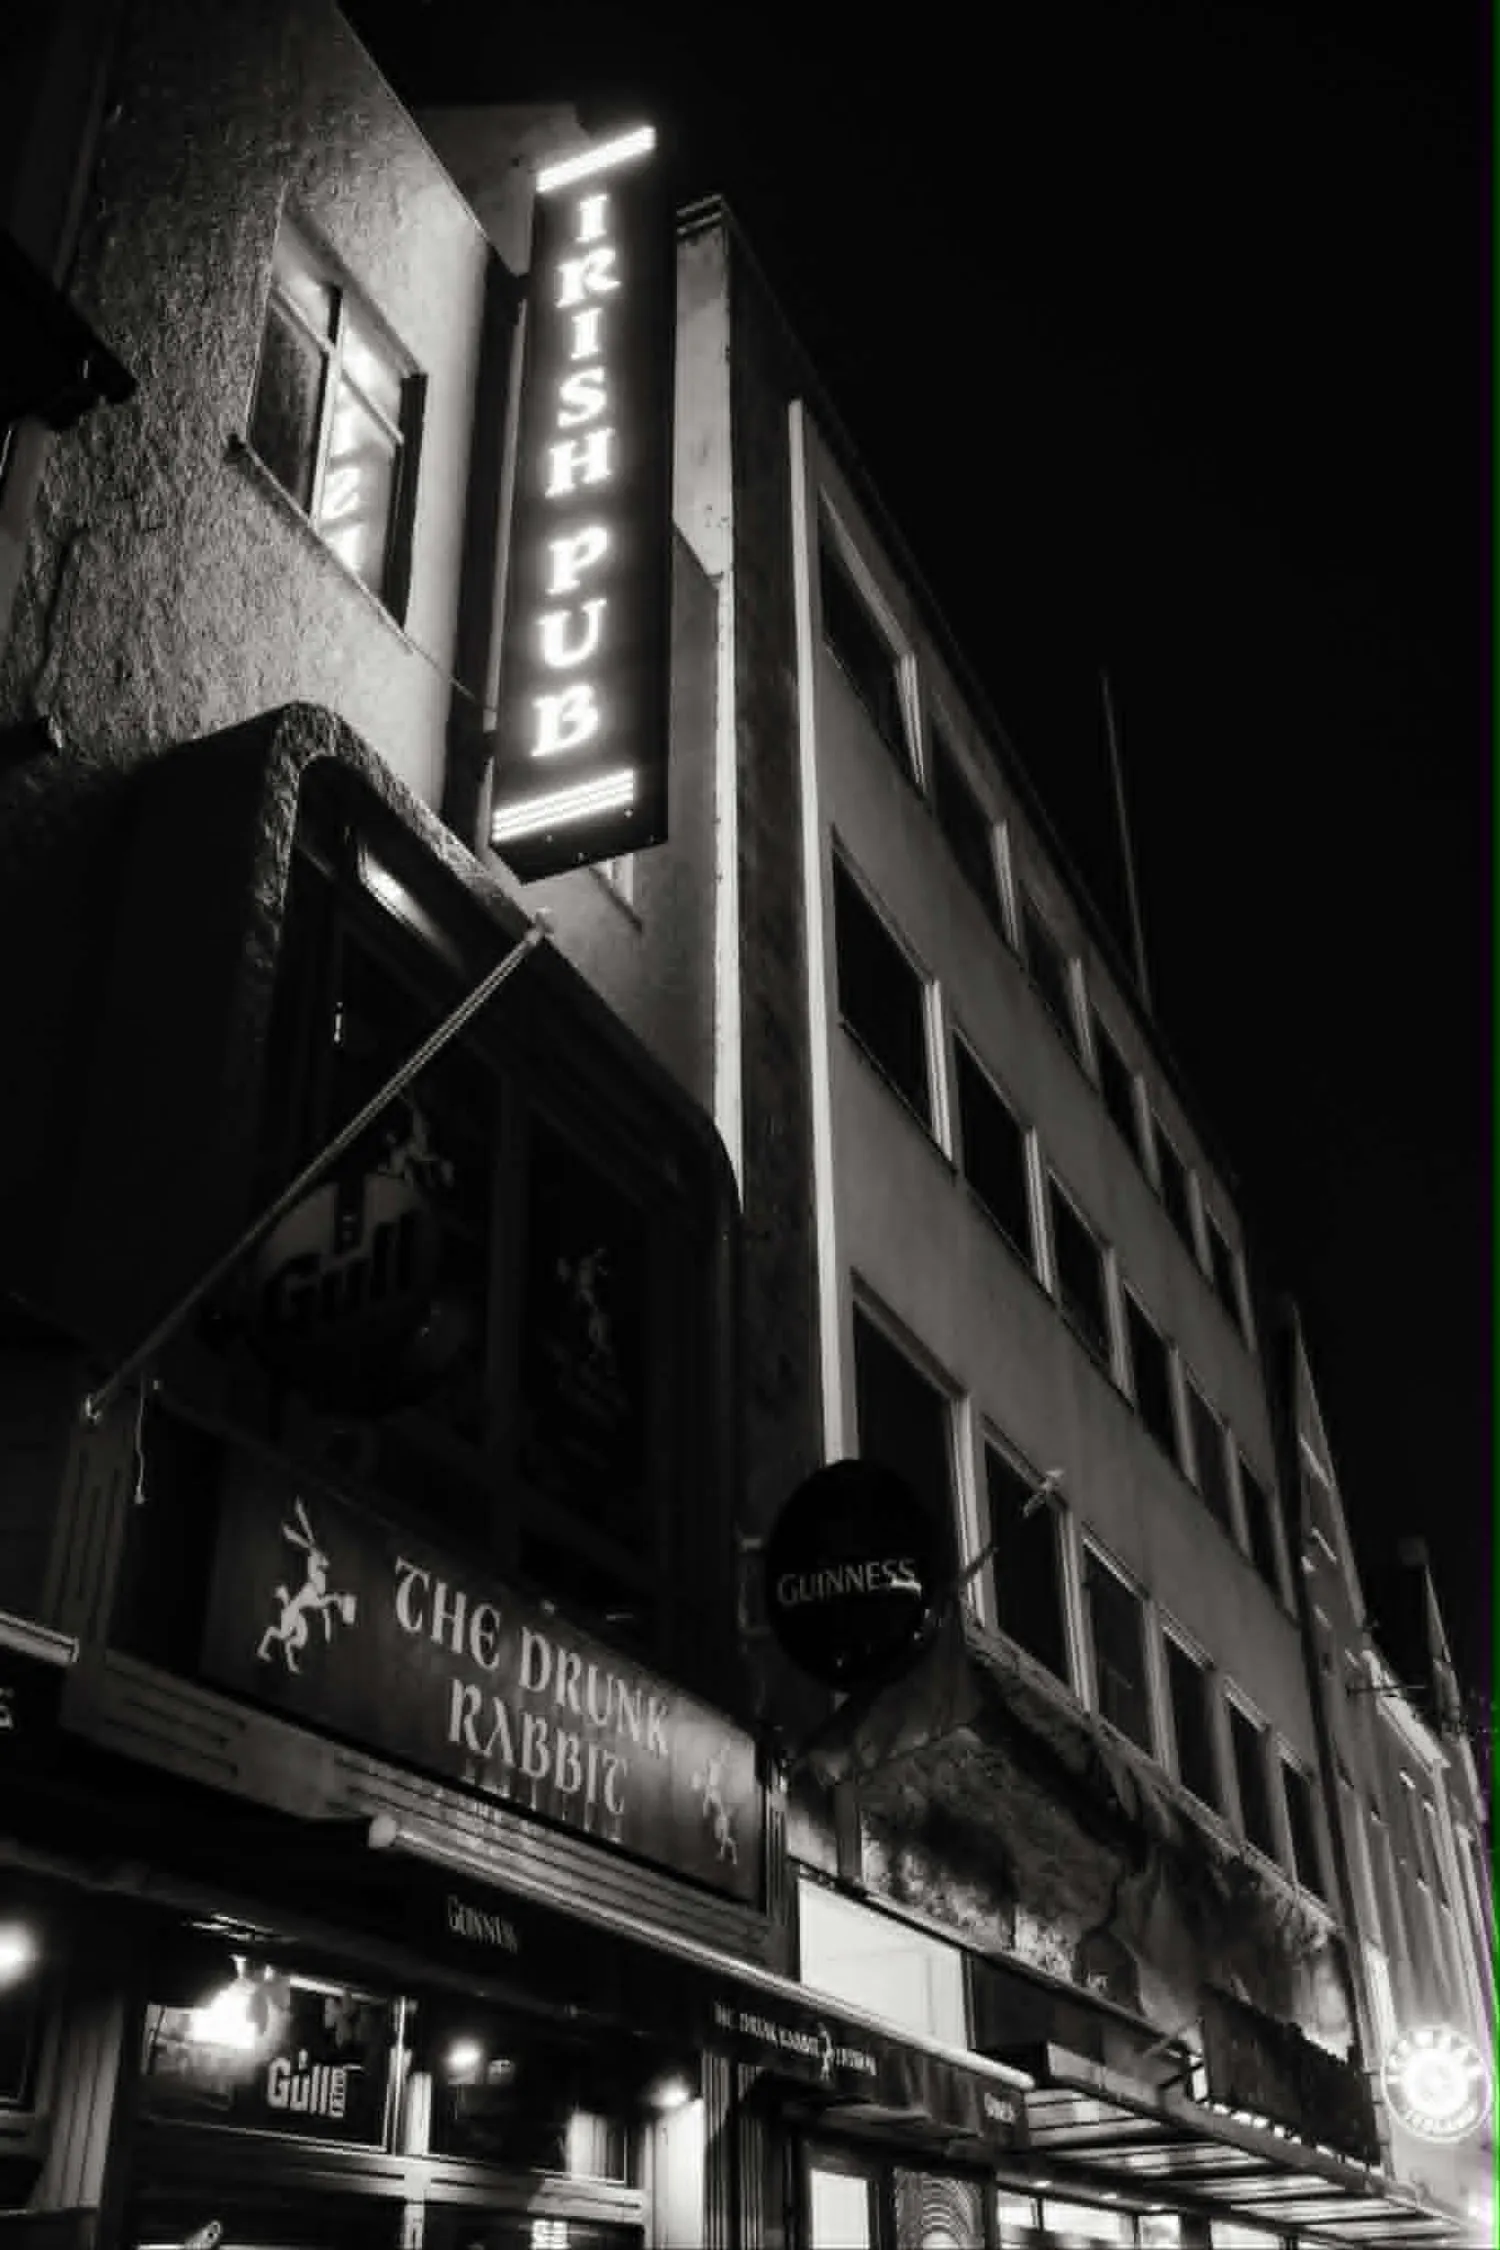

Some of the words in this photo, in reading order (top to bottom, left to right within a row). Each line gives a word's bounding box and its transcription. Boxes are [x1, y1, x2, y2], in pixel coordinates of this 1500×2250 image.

[546, 193, 621, 498] IRISH
[531, 526, 608, 757] PUB
[394, 1555, 500, 1670] THE
[518, 1626, 669, 1757] DRUNK
[776, 1557, 918, 1608] GUINNESS
[447, 1678, 628, 1816] RABBIT
